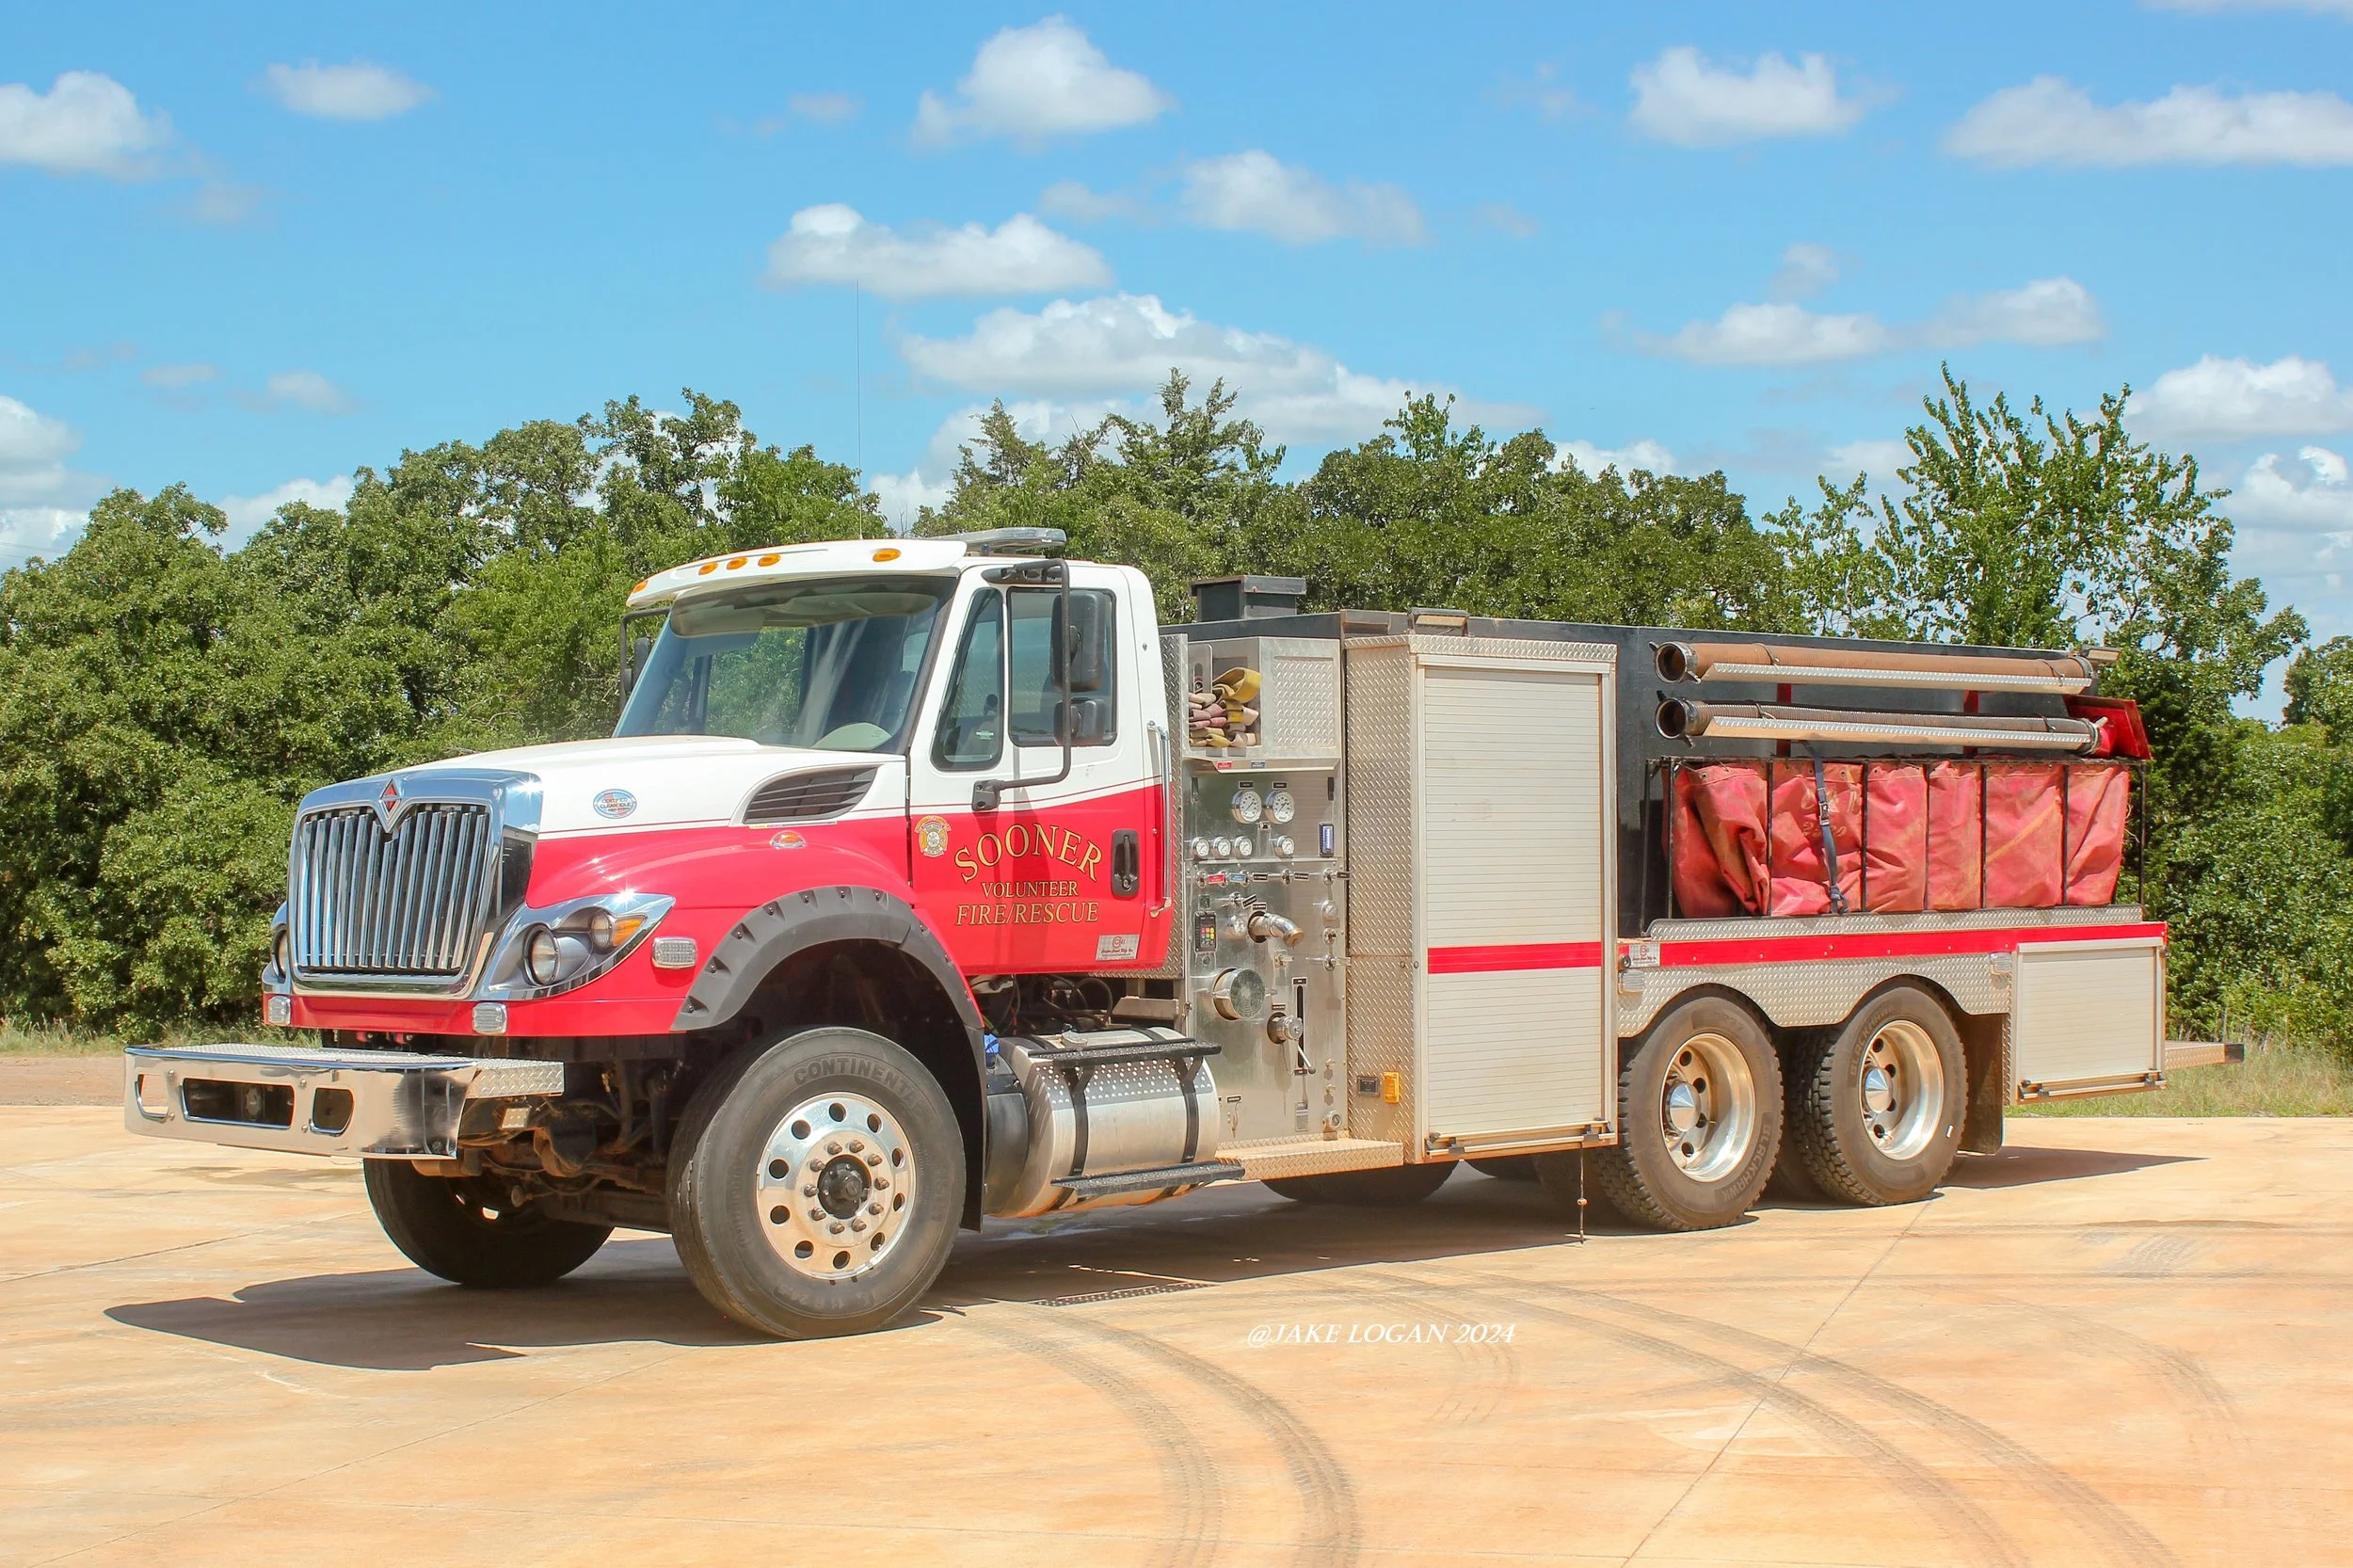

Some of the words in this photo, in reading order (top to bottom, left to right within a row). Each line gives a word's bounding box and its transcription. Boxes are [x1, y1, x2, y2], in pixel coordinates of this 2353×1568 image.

[954, 823, 1102, 883] SOONER
[956, 901, 1099, 926] FIRE/RESCUE
[982, 881, 1079, 898] VOLUNTEER
[792, 1057, 922, 1109] CONTINENTA
[1721, 1124, 1771, 1201] BLACKHAWK
